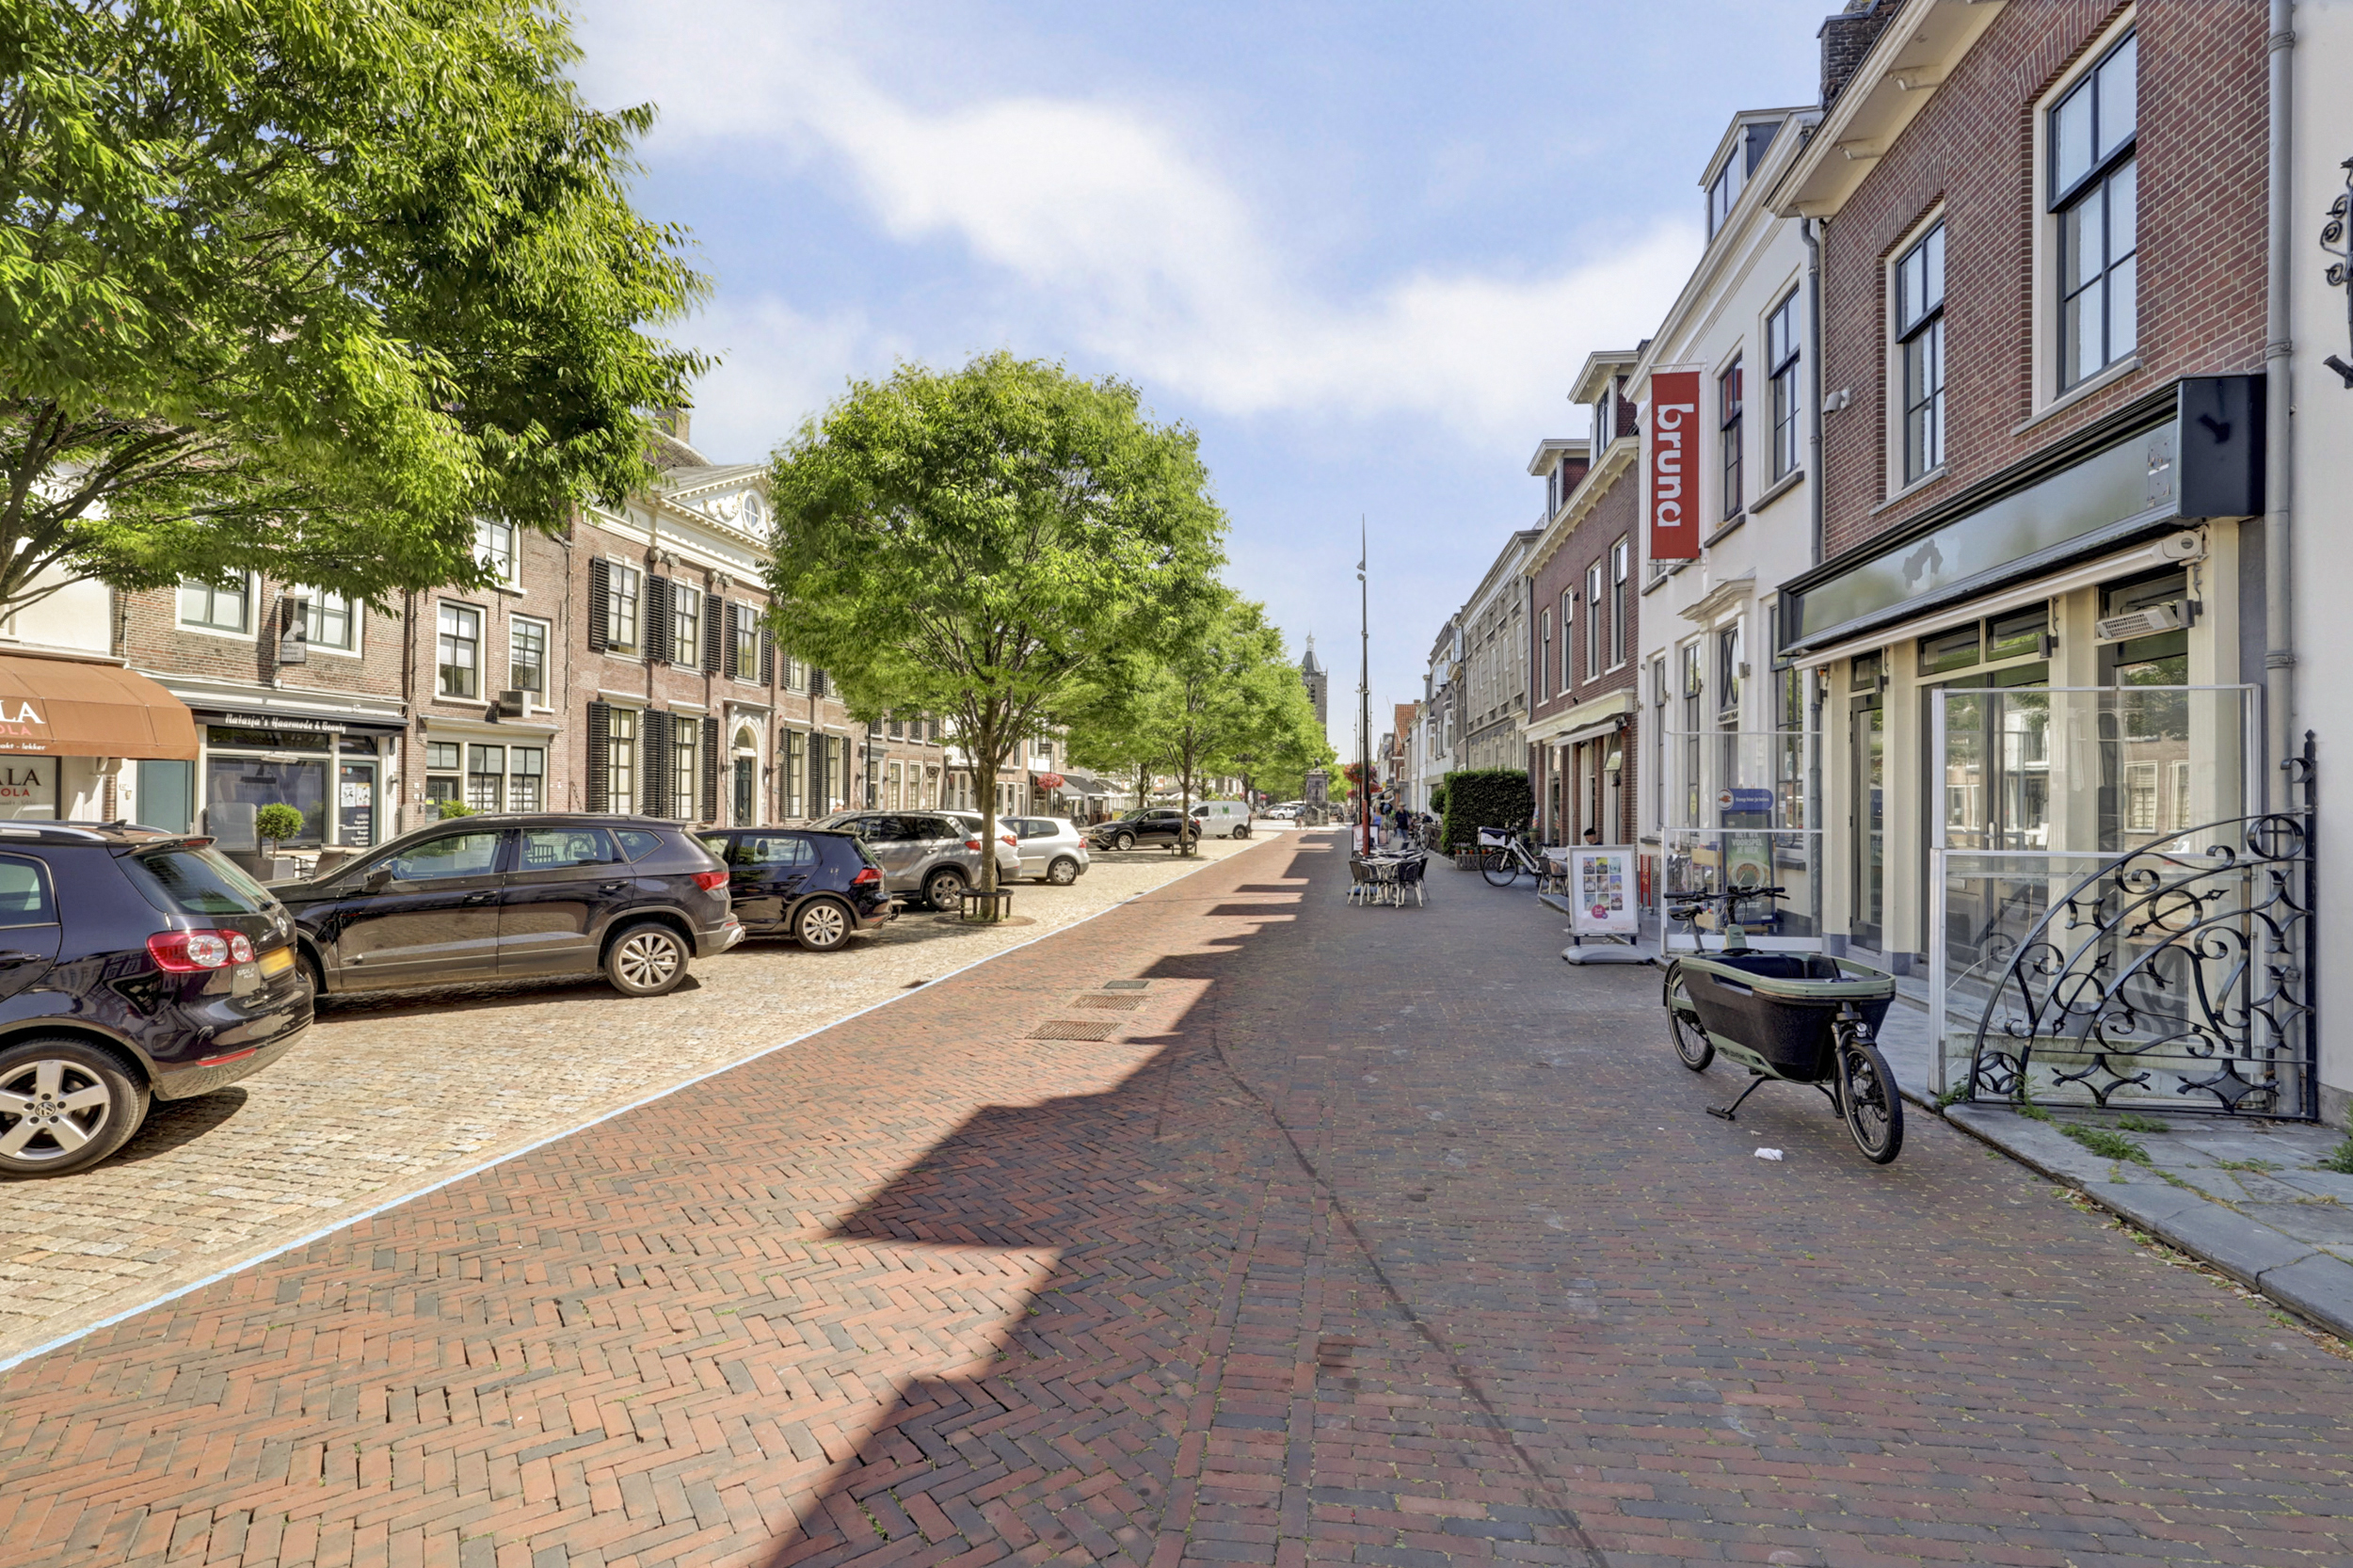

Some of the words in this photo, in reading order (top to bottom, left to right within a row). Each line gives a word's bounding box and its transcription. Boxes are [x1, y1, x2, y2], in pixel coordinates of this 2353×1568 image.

[1657, 403, 1695, 527] bruna
[225, 712, 269, 728] Natasja's
[271, 716, 313, 730] Haarmode
[314, 721, 321, 730] &
[322, 721, 347, 734] Beauty
